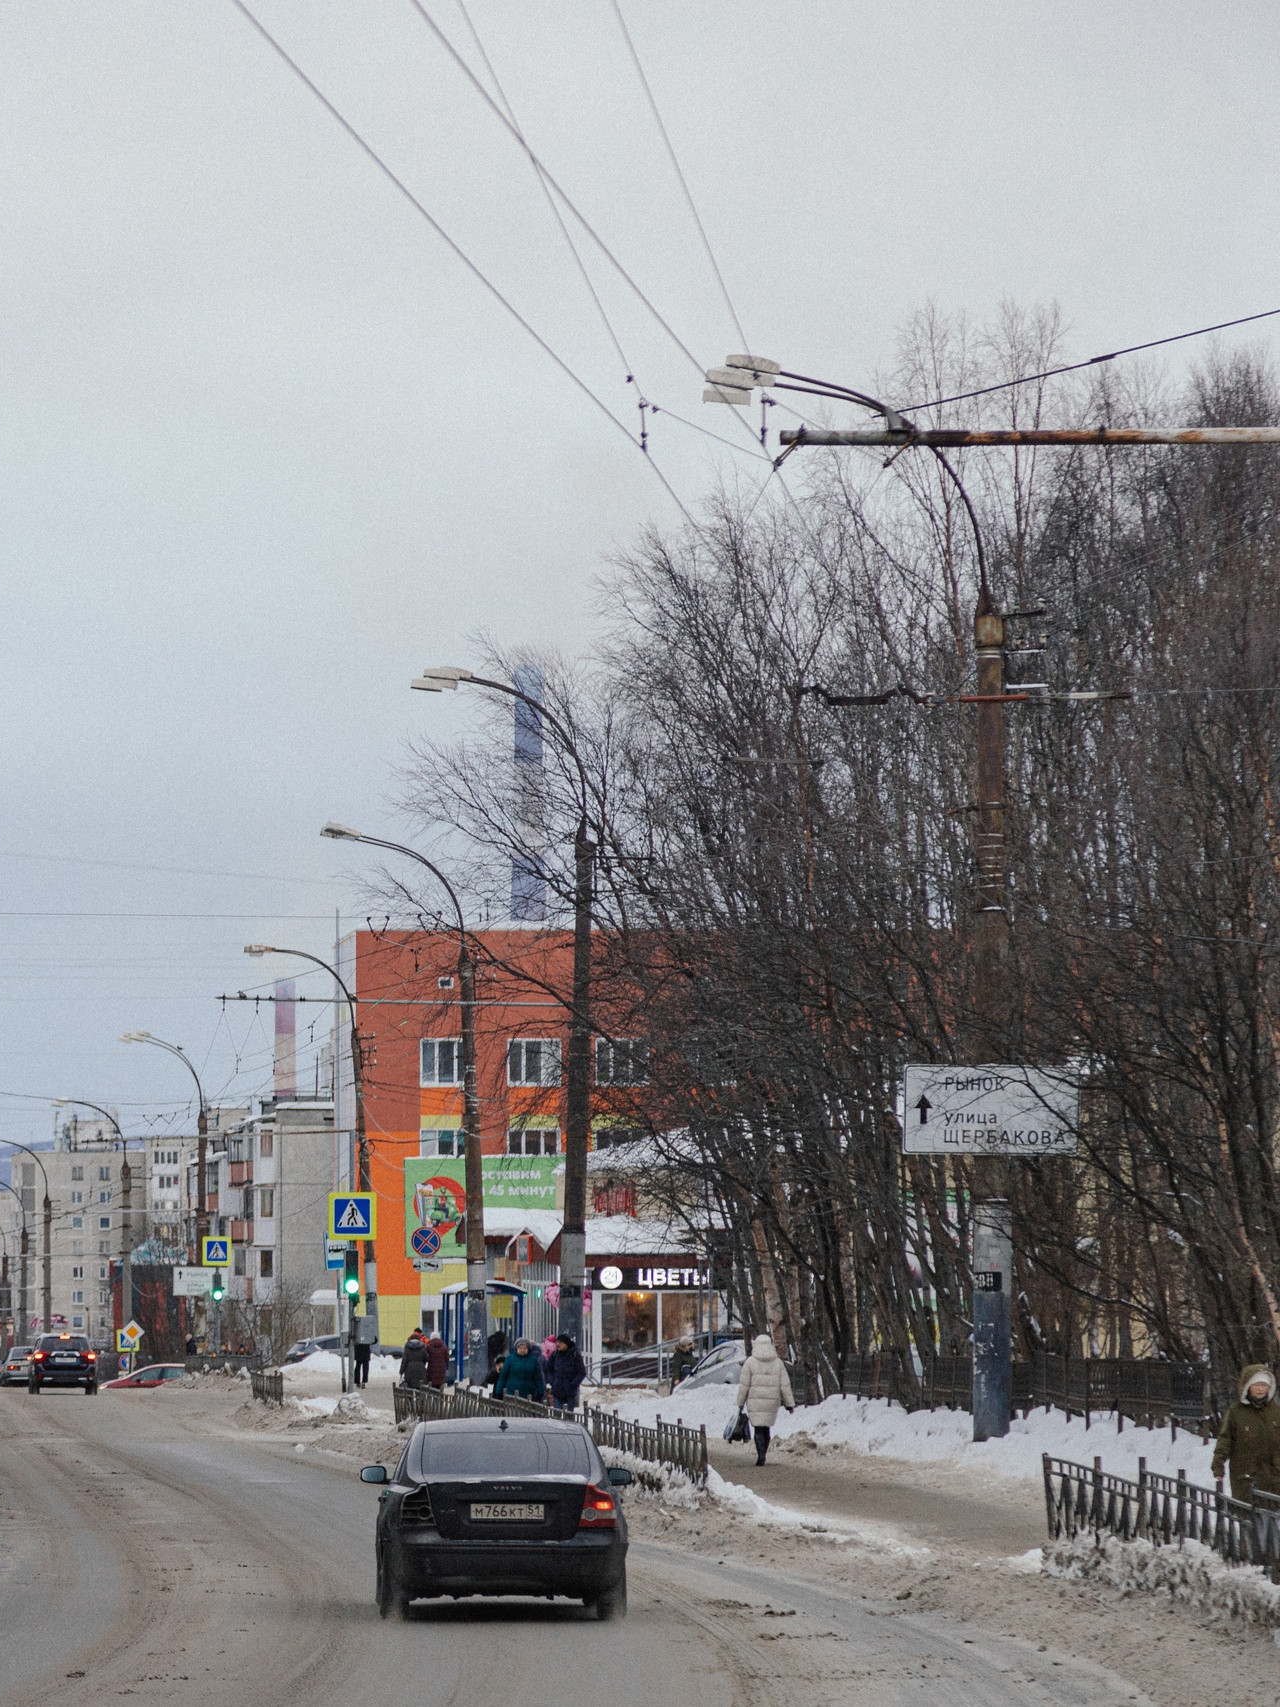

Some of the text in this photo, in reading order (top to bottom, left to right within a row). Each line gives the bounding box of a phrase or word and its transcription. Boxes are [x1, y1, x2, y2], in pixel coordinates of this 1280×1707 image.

[944, 1077, 1005, 1092] РЫНОК
[944, 1112, 998, 1127] улица
[943, 1129, 1066, 1145] ЩЕРБАКОВА
[481, 1169, 541, 1180] оставим
[489, 1184, 505, 1196] 45
[508, 1186, 556, 1198] минут
[637, 1268, 710, 1288] ЦВЕТЫ
